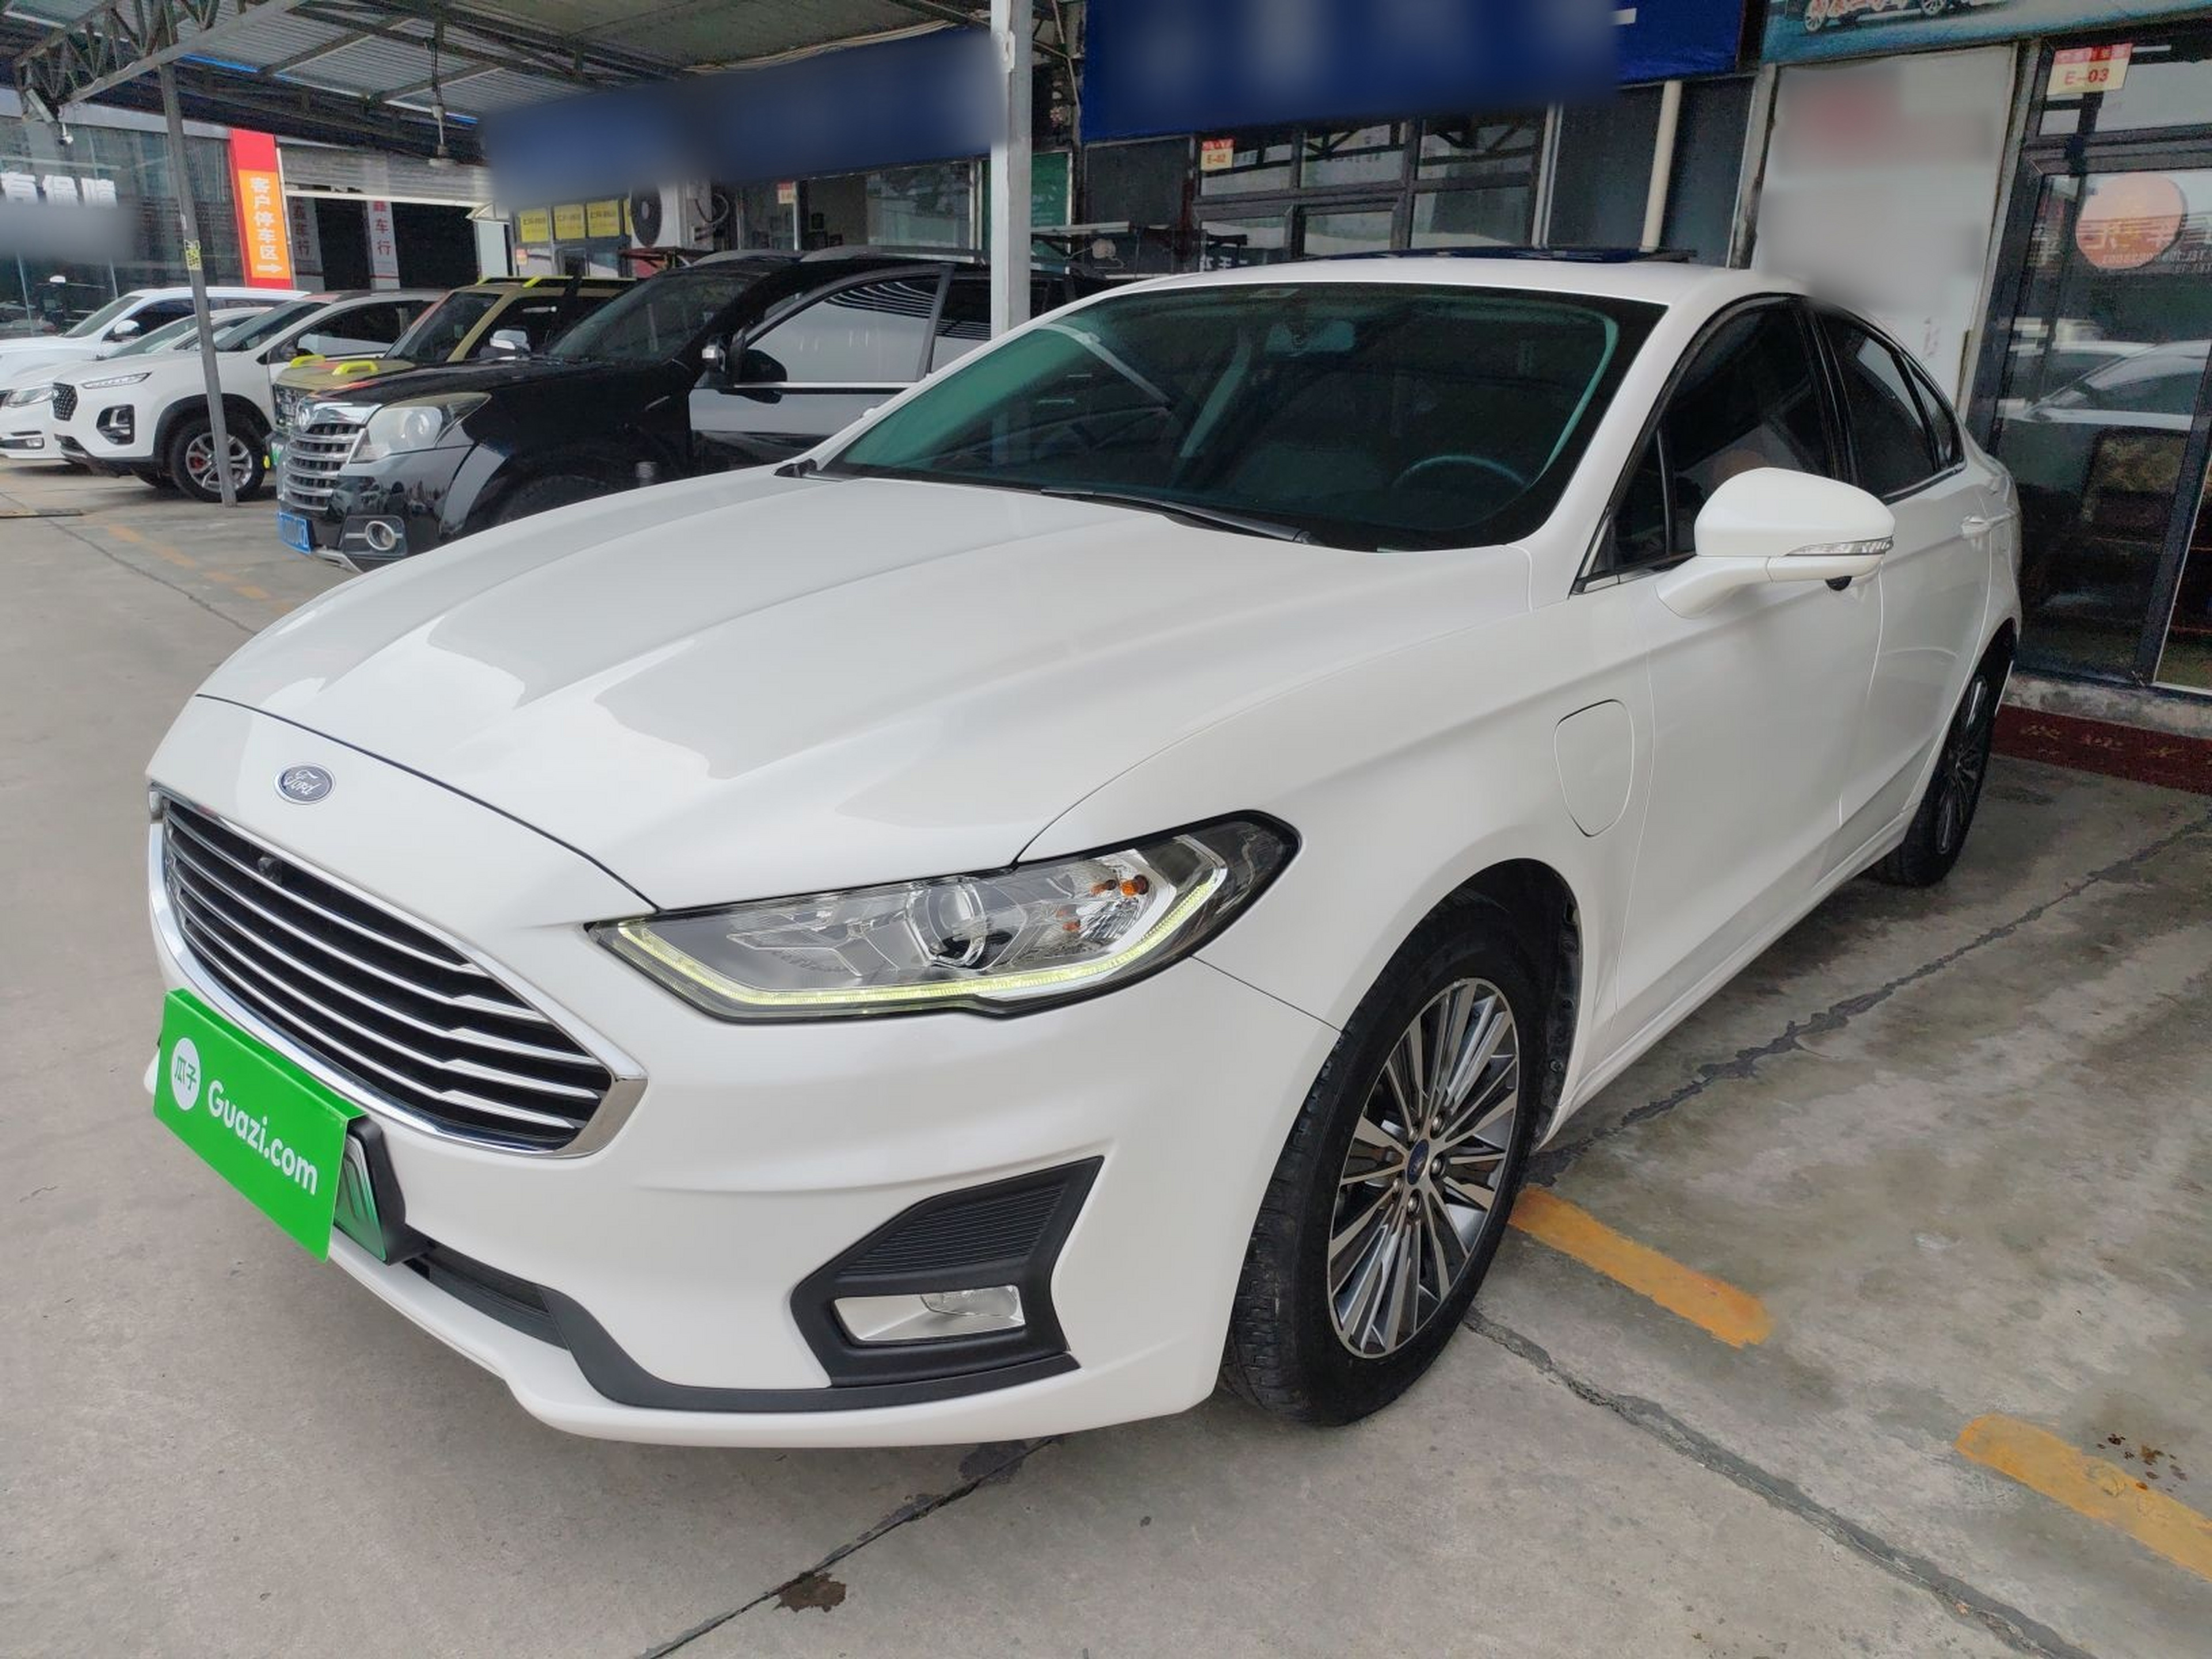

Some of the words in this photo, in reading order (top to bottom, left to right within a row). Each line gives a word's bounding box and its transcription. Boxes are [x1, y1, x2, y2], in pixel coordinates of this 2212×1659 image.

[249, 177, 279, 260] 客户停车区
[285, 769, 322, 796] Ford
[174, 1055, 197, 1091] 瓜子
[208, 1079, 318, 1196] Guazi.com
